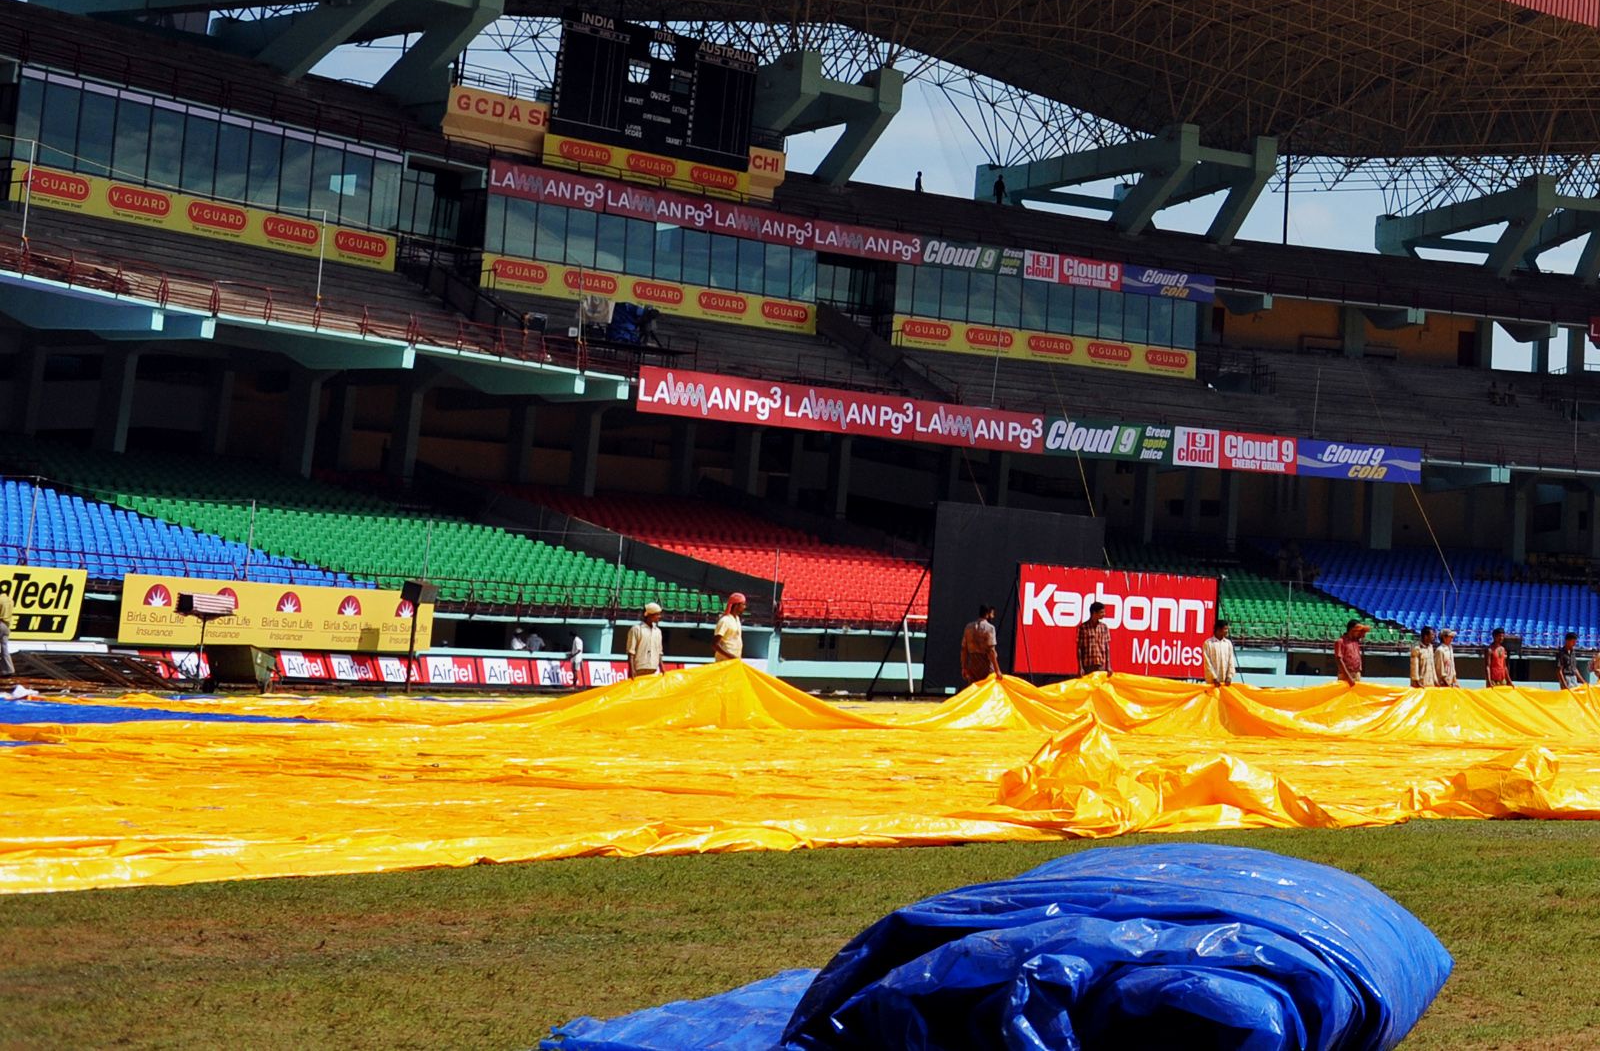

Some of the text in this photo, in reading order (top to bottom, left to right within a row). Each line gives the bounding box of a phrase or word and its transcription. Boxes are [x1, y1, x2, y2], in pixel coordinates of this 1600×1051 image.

[581, 12, 615, 30] INDIA
[654, 30, 676, 44] TOTAL
[698, 41, 756, 64] AUSTRALIA
[748, 155, 779, 173] CHI
[29, 175, 86, 196] -GUARD
[112, 190, 166, 212] V-GUARD
[191, 206, 244, 226] V-GUARD
[267, 221, 315, 240] V-GUARD
[339, 235, 384, 253] V-GUARD
[923, 240, 995, 269] Cloud 9
[1063, 257, 1119, 281] Cloud 9
[1045, 420, 1136, 454] Cloud 9
[1195, 435, 1206, 447] 9
[1177, 446, 1214, 463] cloud
[1224, 435, 1294, 462] Cloud 9
[1348, 465, 1388, 479] cola
[1022, 582, 1205, 633] Karbonn
[127, 611, 147, 622] Birla
[149, 613, 167, 623] Sun
[169, 614, 185, 624] Life
[217, 617, 234, 626] Sun
[236, 616, 251, 626] Life
[261, 617, 313, 629] Birla Sun Life
[323, 621, 341, 630] Birla
[342, 621, 357, 630] Sun
[136, 627, 173, 637] Insurance
[205, 629, 241, 639] Insurance
[382, 622, 398, 632] Birla
[399, 623, 411, 632] Su
[270, 631, 303, 642] Insurance
[331, 633, 363, 643] Insurance
[1131, 638, 1203, 666] Mobiles
[287, 658, 324, 677] Airtel
[337, 661, 372, 679] Airtel
[432, 663, 473, 682] Airtel
[488, 664, 527, 683] Airtel
[542, 667, 578, 684] Airte
[593, 668, 628, 684] Airtel
